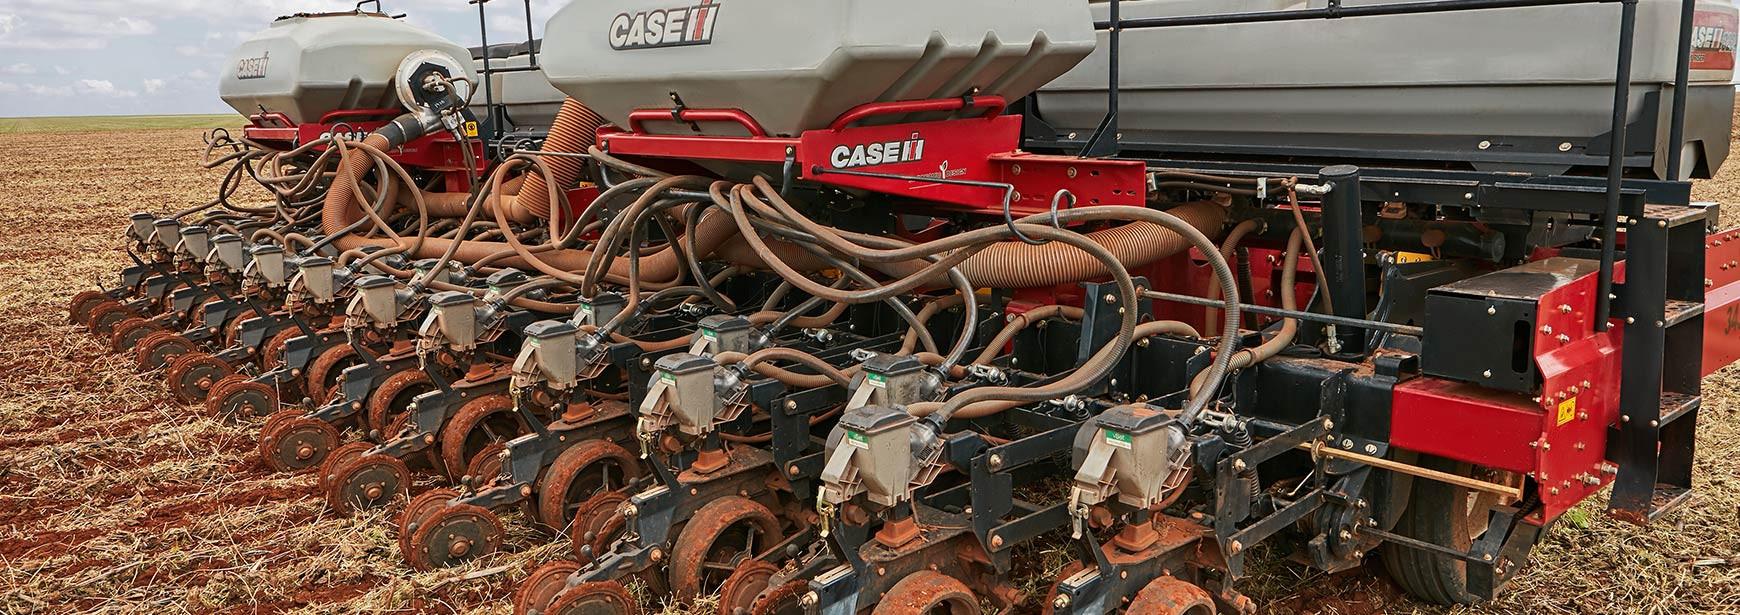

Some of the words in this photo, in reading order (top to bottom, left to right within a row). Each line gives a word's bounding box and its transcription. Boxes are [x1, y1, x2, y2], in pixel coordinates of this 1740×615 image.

[609, 8, 687, 48] CASE
[1692, 26, 1714, 49] ASE
[830, 141, 901, 168] CASE
